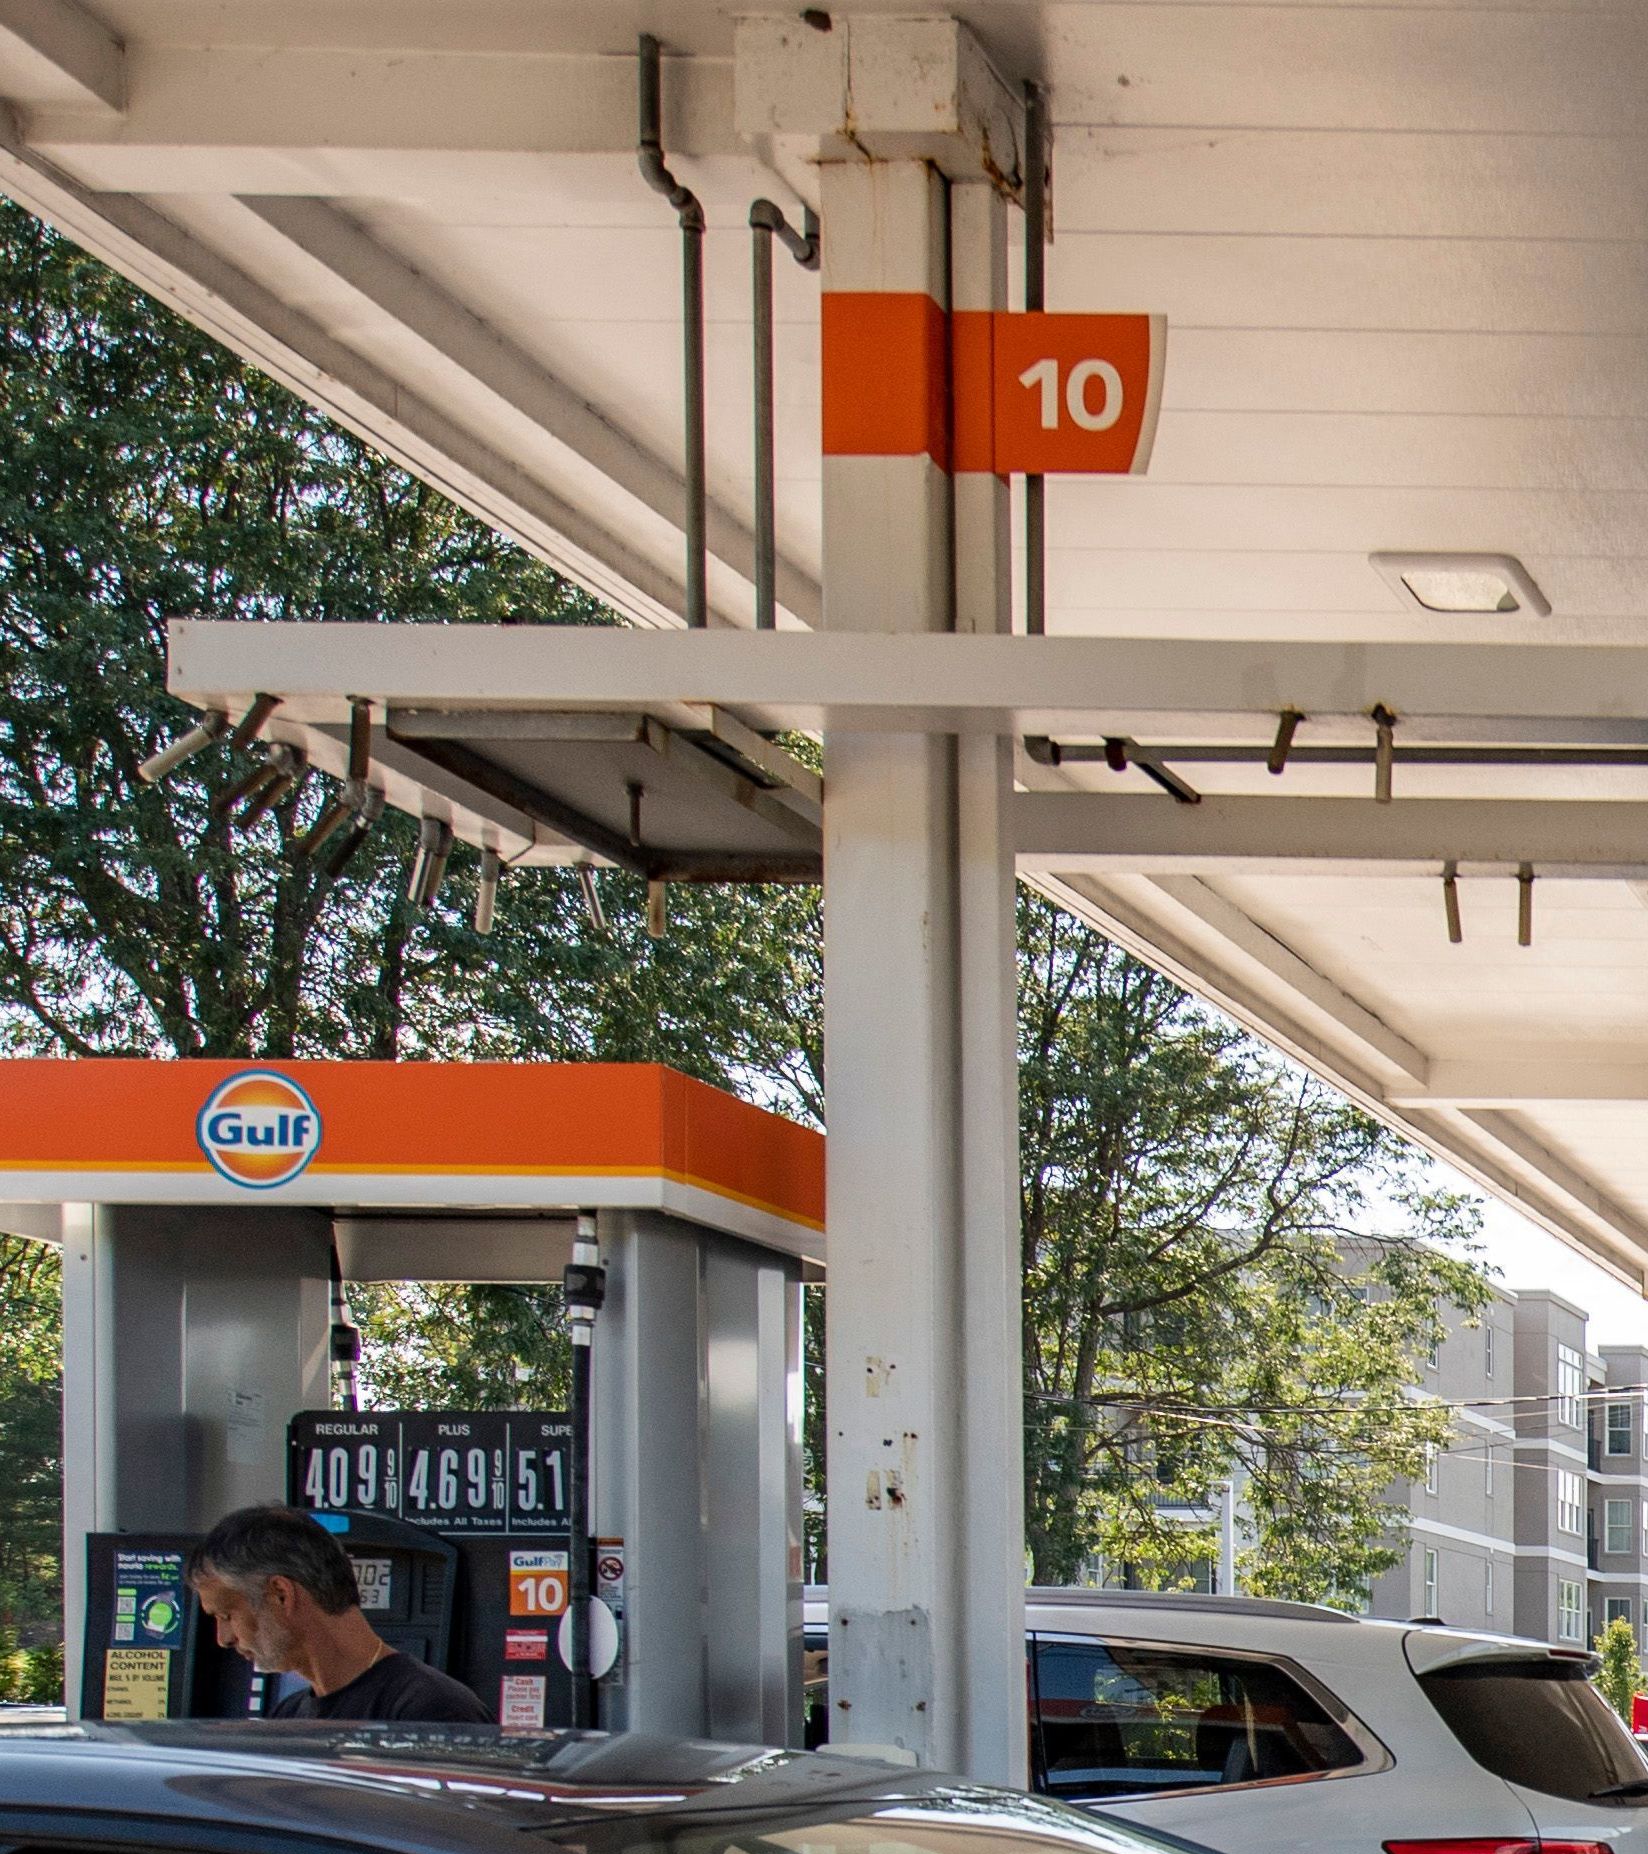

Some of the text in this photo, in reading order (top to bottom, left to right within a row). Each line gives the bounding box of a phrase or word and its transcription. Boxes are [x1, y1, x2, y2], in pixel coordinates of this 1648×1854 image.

[1018, 358, 1124, 432] 10
[207, 1112, 311, 1147] Gulf
[315, 1423, 378, 1436] REGULAR
[438, 1424, 471, 1437] PLUS
[540, 1425, 573, 1437] SUPE
[409, 1448, 486, 1511] 4.69
[518, 1450, 566, 1512] 5.1
[518, 1577, 563, 1611] 10
[110, 1662, 165, 1670] CONTENT
[111, 1651, 165, 1659] ALCOHOL
